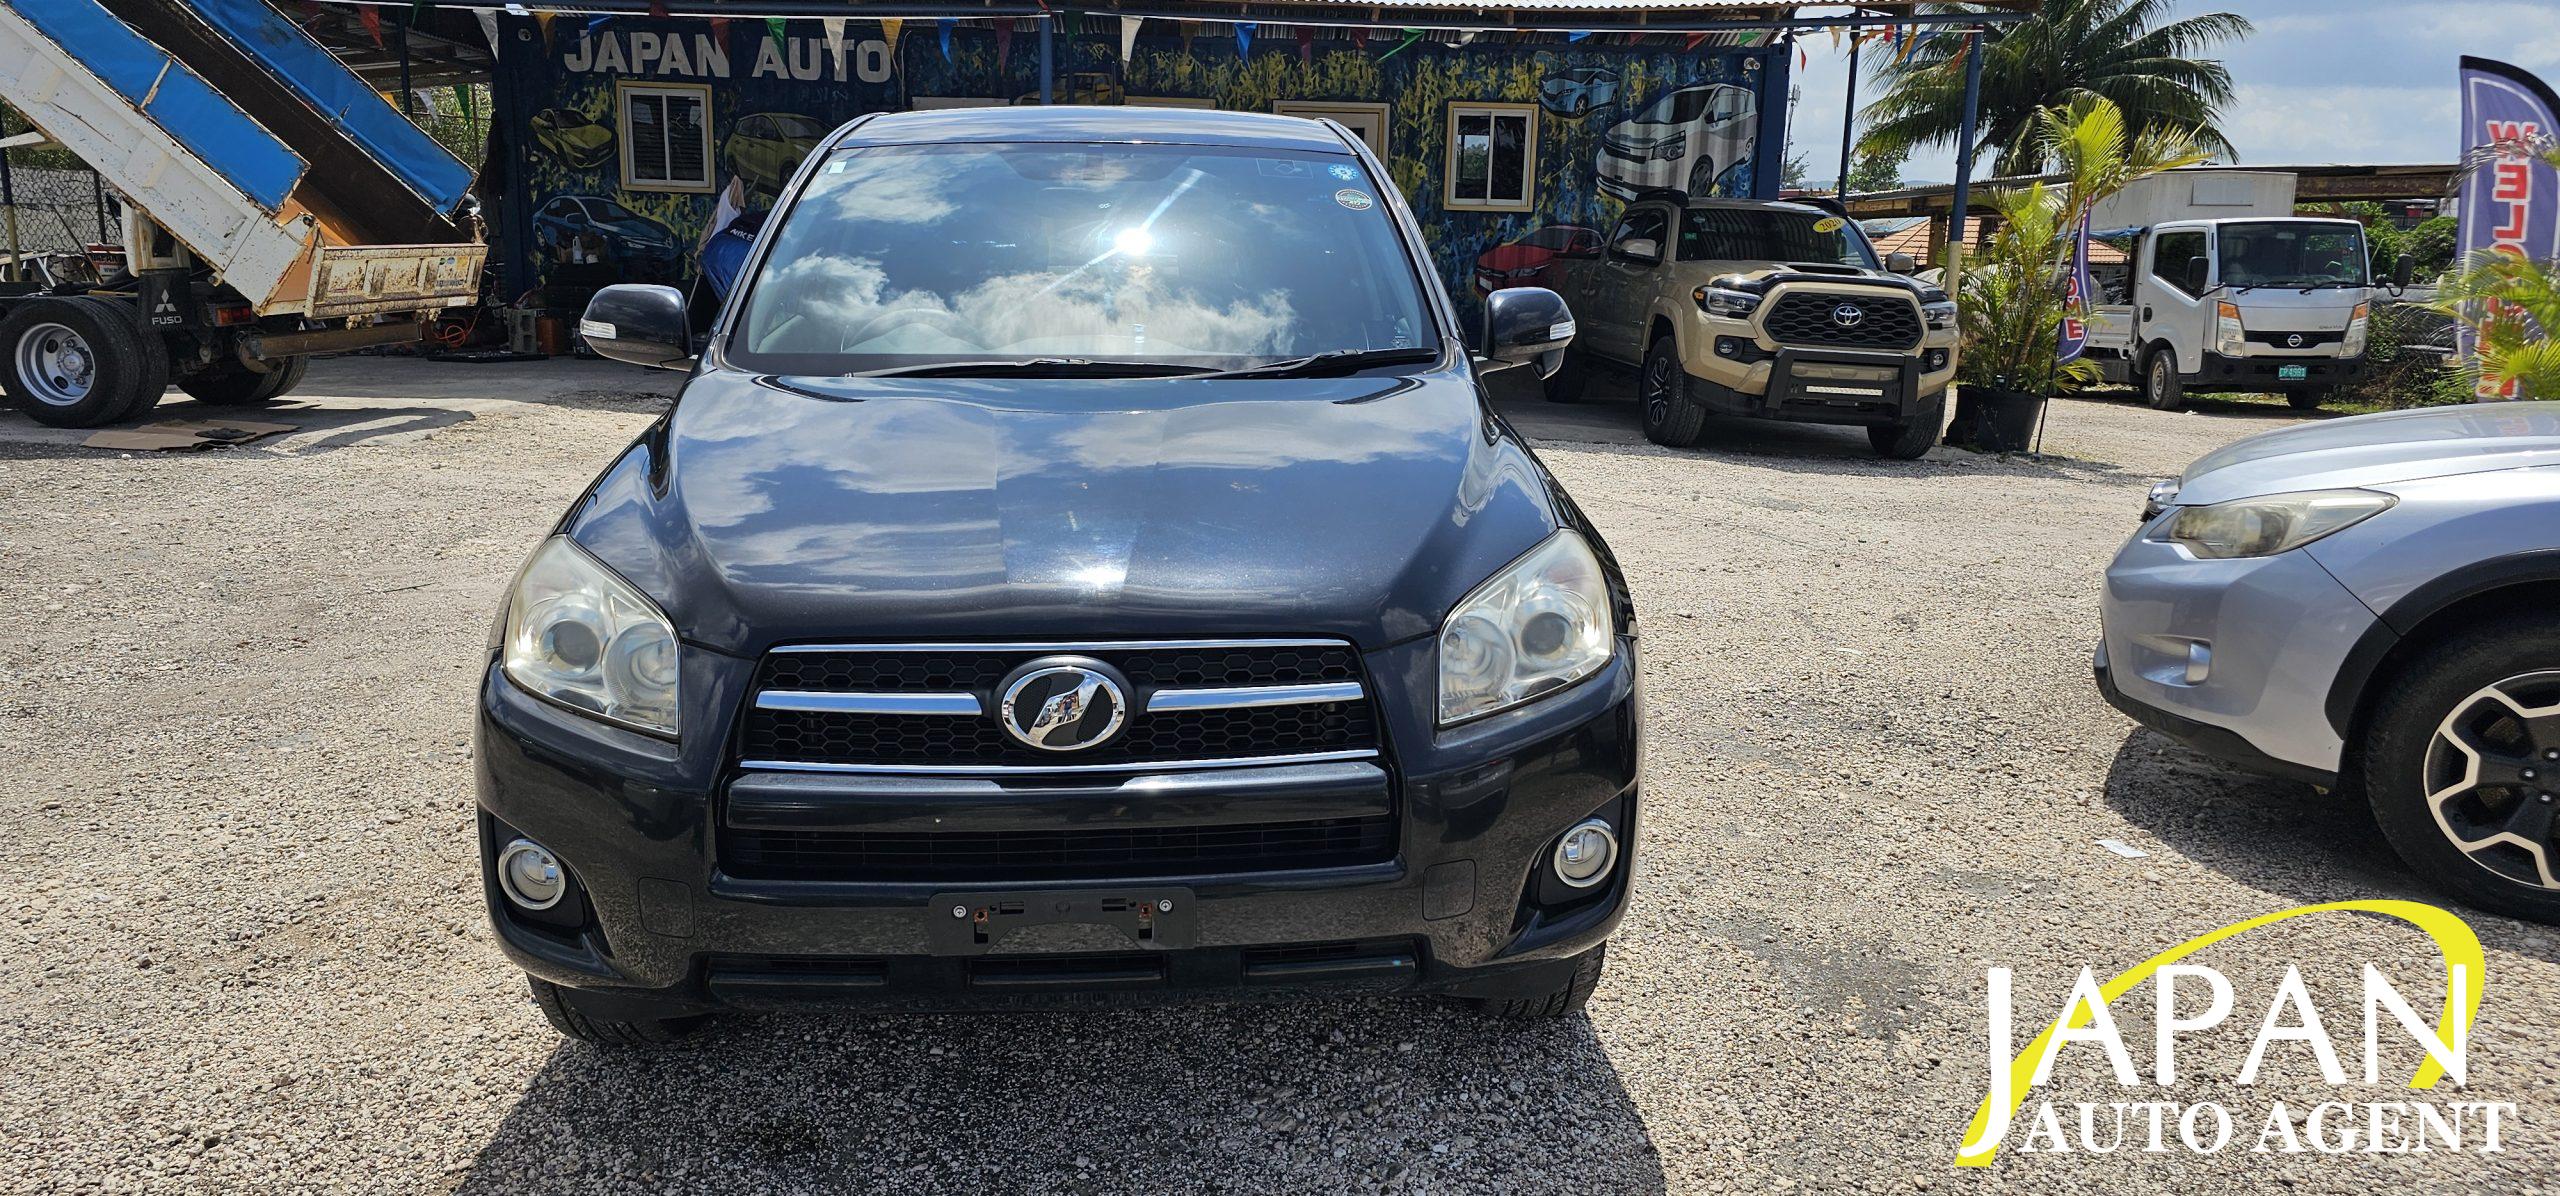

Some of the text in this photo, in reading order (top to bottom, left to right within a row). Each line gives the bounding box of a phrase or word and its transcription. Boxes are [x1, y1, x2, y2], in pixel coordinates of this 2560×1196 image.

[563, 29, 892, 84] JAPAN AUTO
[151, 315, 183, 325] FUSO
